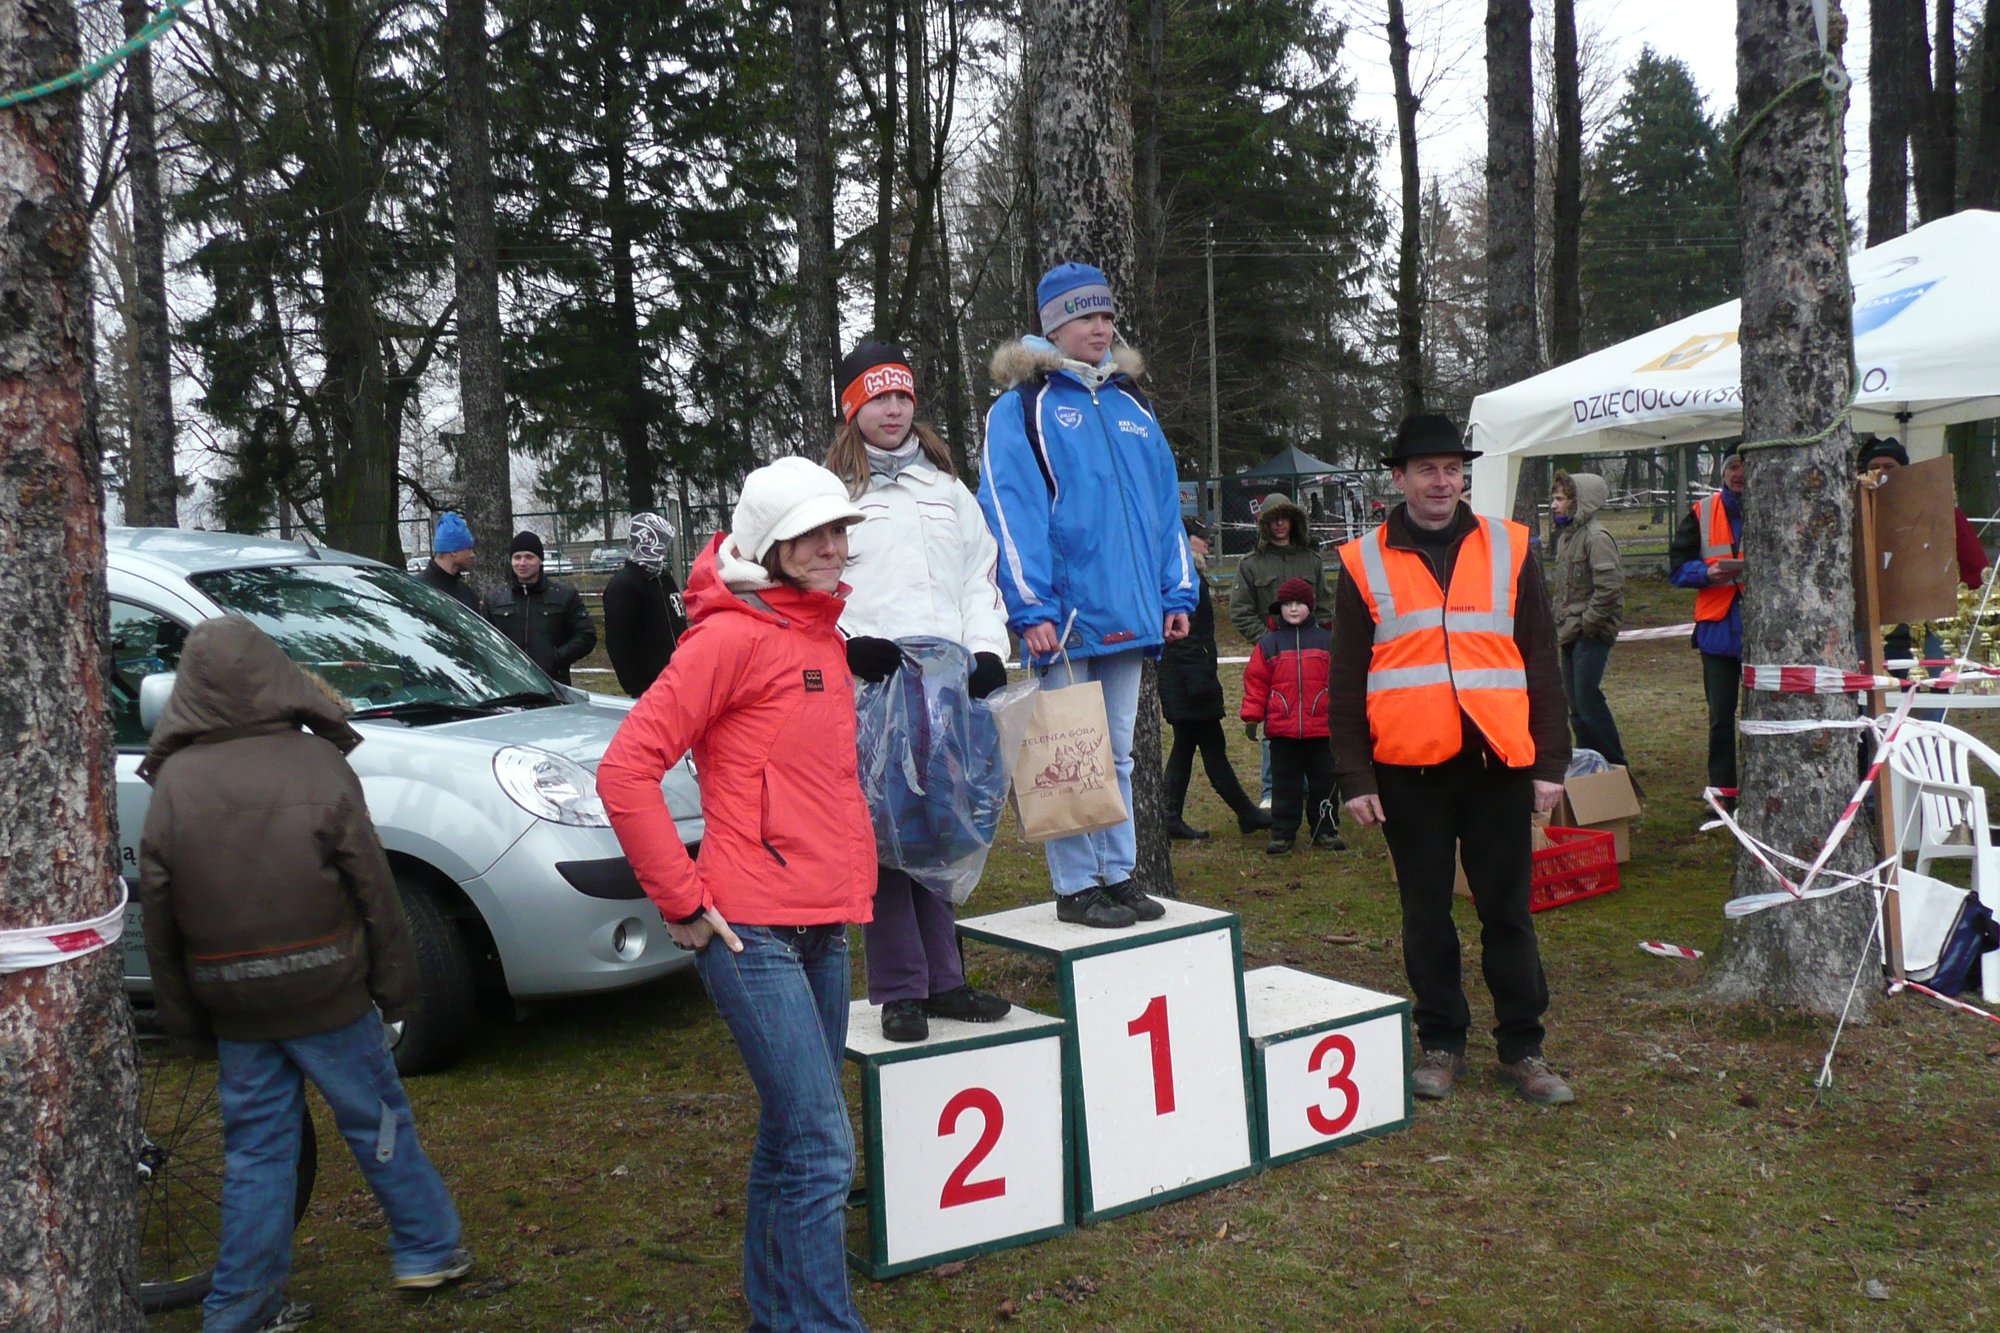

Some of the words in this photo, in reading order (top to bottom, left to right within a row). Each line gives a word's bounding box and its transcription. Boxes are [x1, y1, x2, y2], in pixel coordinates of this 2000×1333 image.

[1074, 294, 1111, 311] Fortum
[1021, 732, 1066, 747] JELENIA
[1068, 727, 1096, 737] GÓRA
[1127, 995, 1175, 1116] 1
[1305, 1034, 1360, 1136] 3
[937, 1087, 1007, 1210] 2
